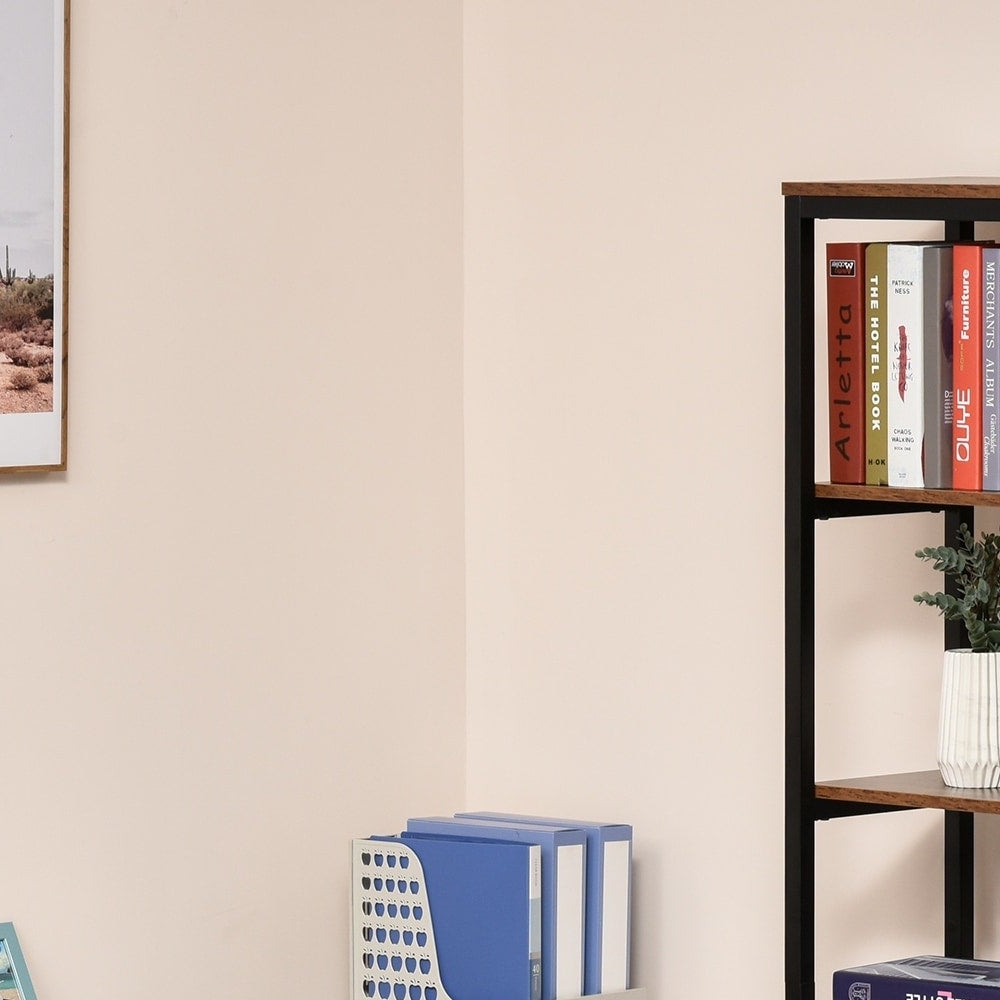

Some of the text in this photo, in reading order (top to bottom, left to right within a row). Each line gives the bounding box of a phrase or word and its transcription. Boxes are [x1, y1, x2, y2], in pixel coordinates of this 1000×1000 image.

[891, 279, 914, 287] PATRICK
[894, 287, 911, 295] NESS
[960, 269, 970, 341] Furniture
[869, 275, 881, 431] THE HOTEL BOOK
[985, 261, 996, 408] MERCHANTS ALBUM
[833, 304, 852, 461] Arletta
[893, 428, 912, 436] CHAOS
[956, 388, 971, 462] OUYE
